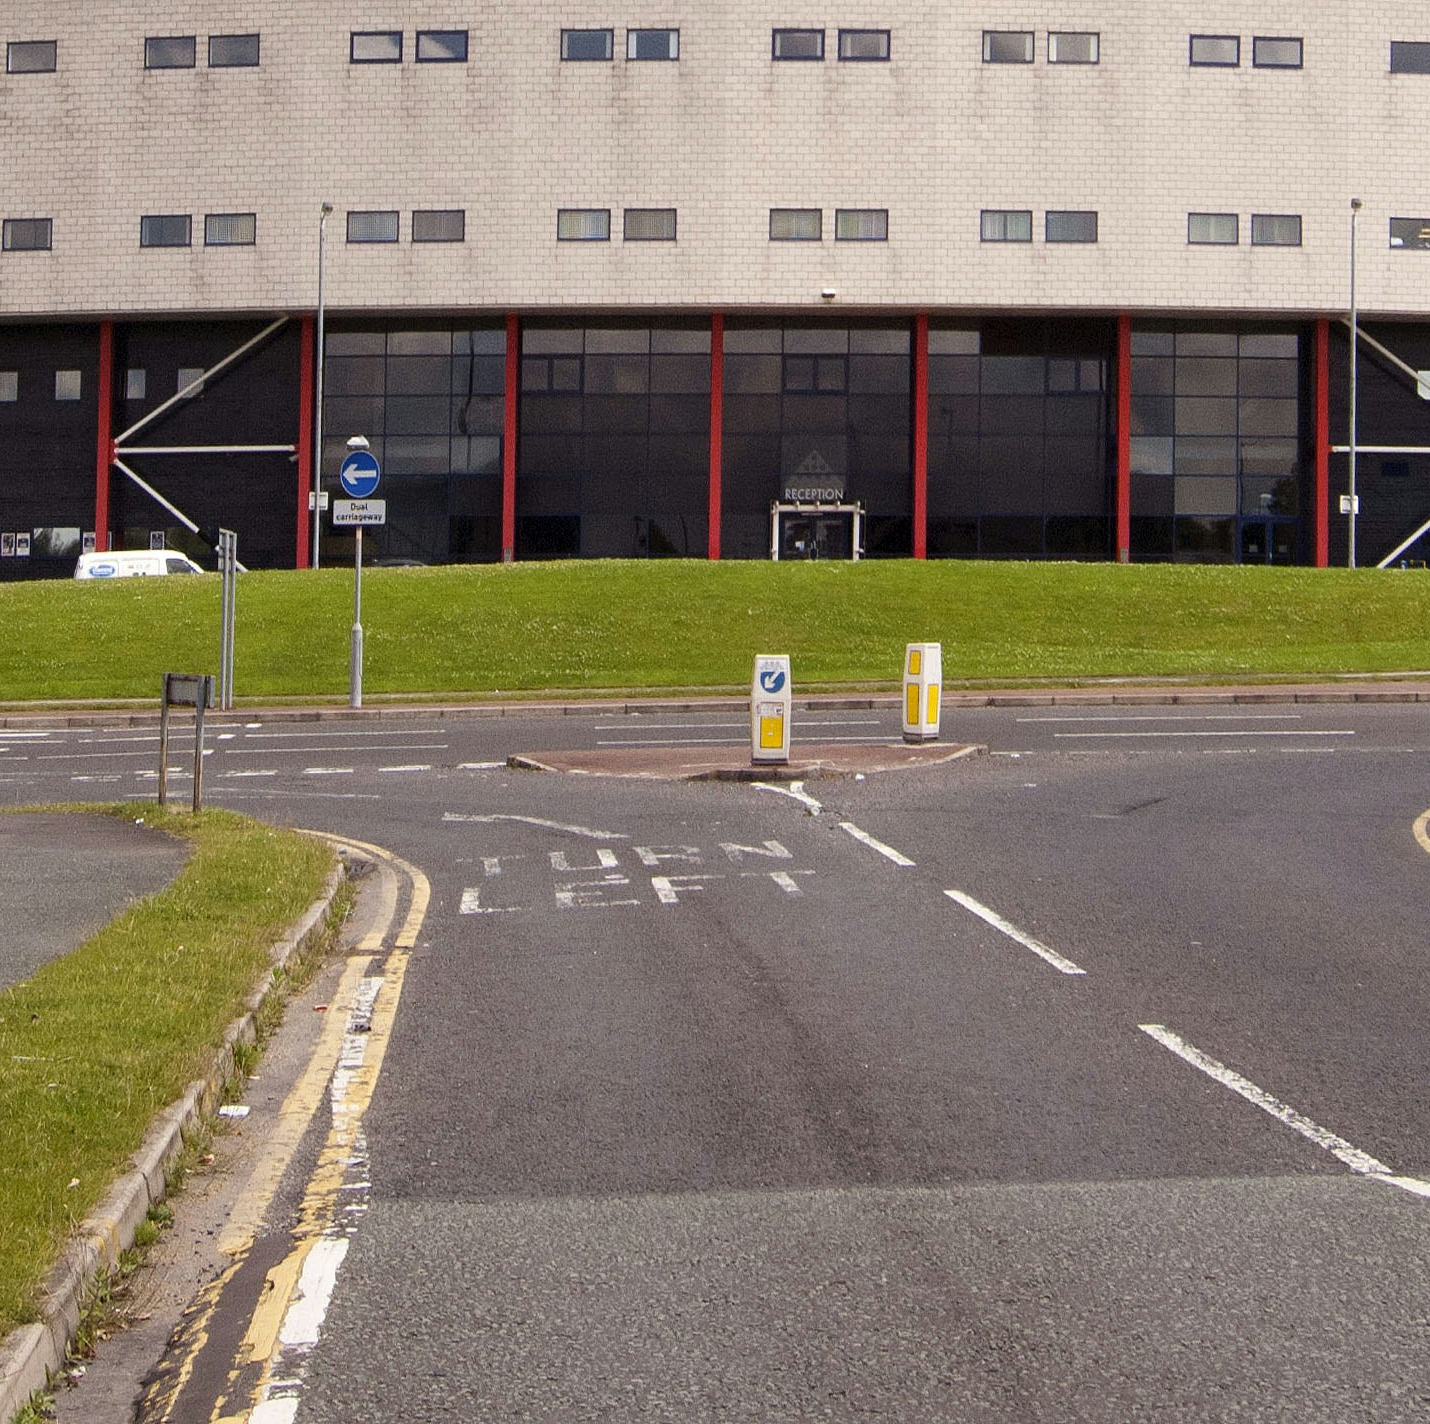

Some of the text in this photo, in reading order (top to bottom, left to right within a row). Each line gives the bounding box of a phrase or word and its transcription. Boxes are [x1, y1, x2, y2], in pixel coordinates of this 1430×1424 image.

[784, 488, 844, 500] RECEPTION
[350, 502, 368, 511] Dual
[336, 513, 383, 522] carriageway
[459, 869, 817, 915] LEFT
